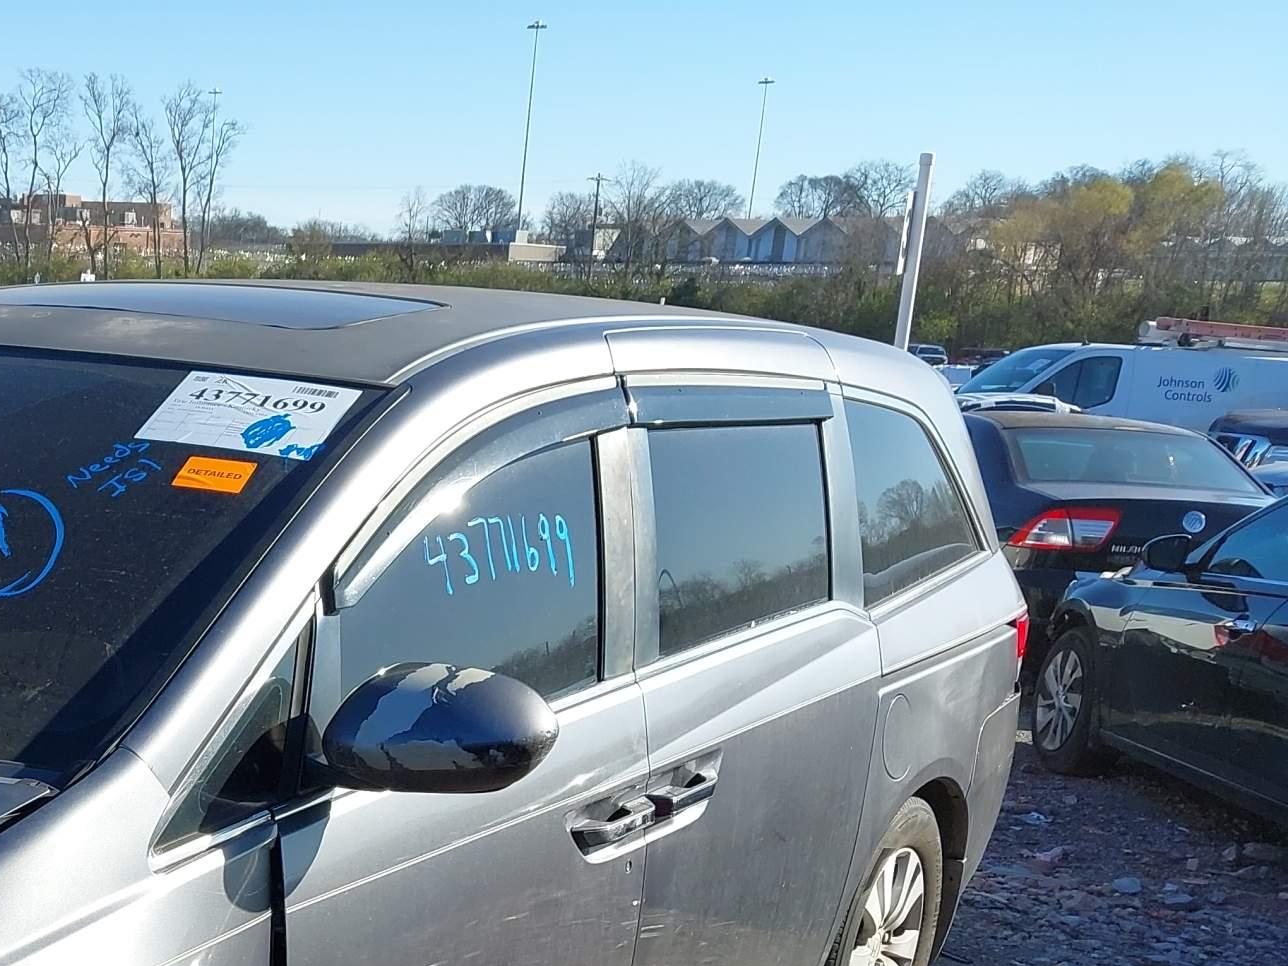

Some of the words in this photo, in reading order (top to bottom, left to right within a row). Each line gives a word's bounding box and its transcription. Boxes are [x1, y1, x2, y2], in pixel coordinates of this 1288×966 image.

[1157, 376, 1205, 389] Johnson
[189, 387, 327, 414] 43771699
[1164, 389, 1212, 403] Controls
[66, 442, 151, 489] Needs
[187, 467, 243, 481] DETAILED
[423, 513, 576, 595] 43771699
